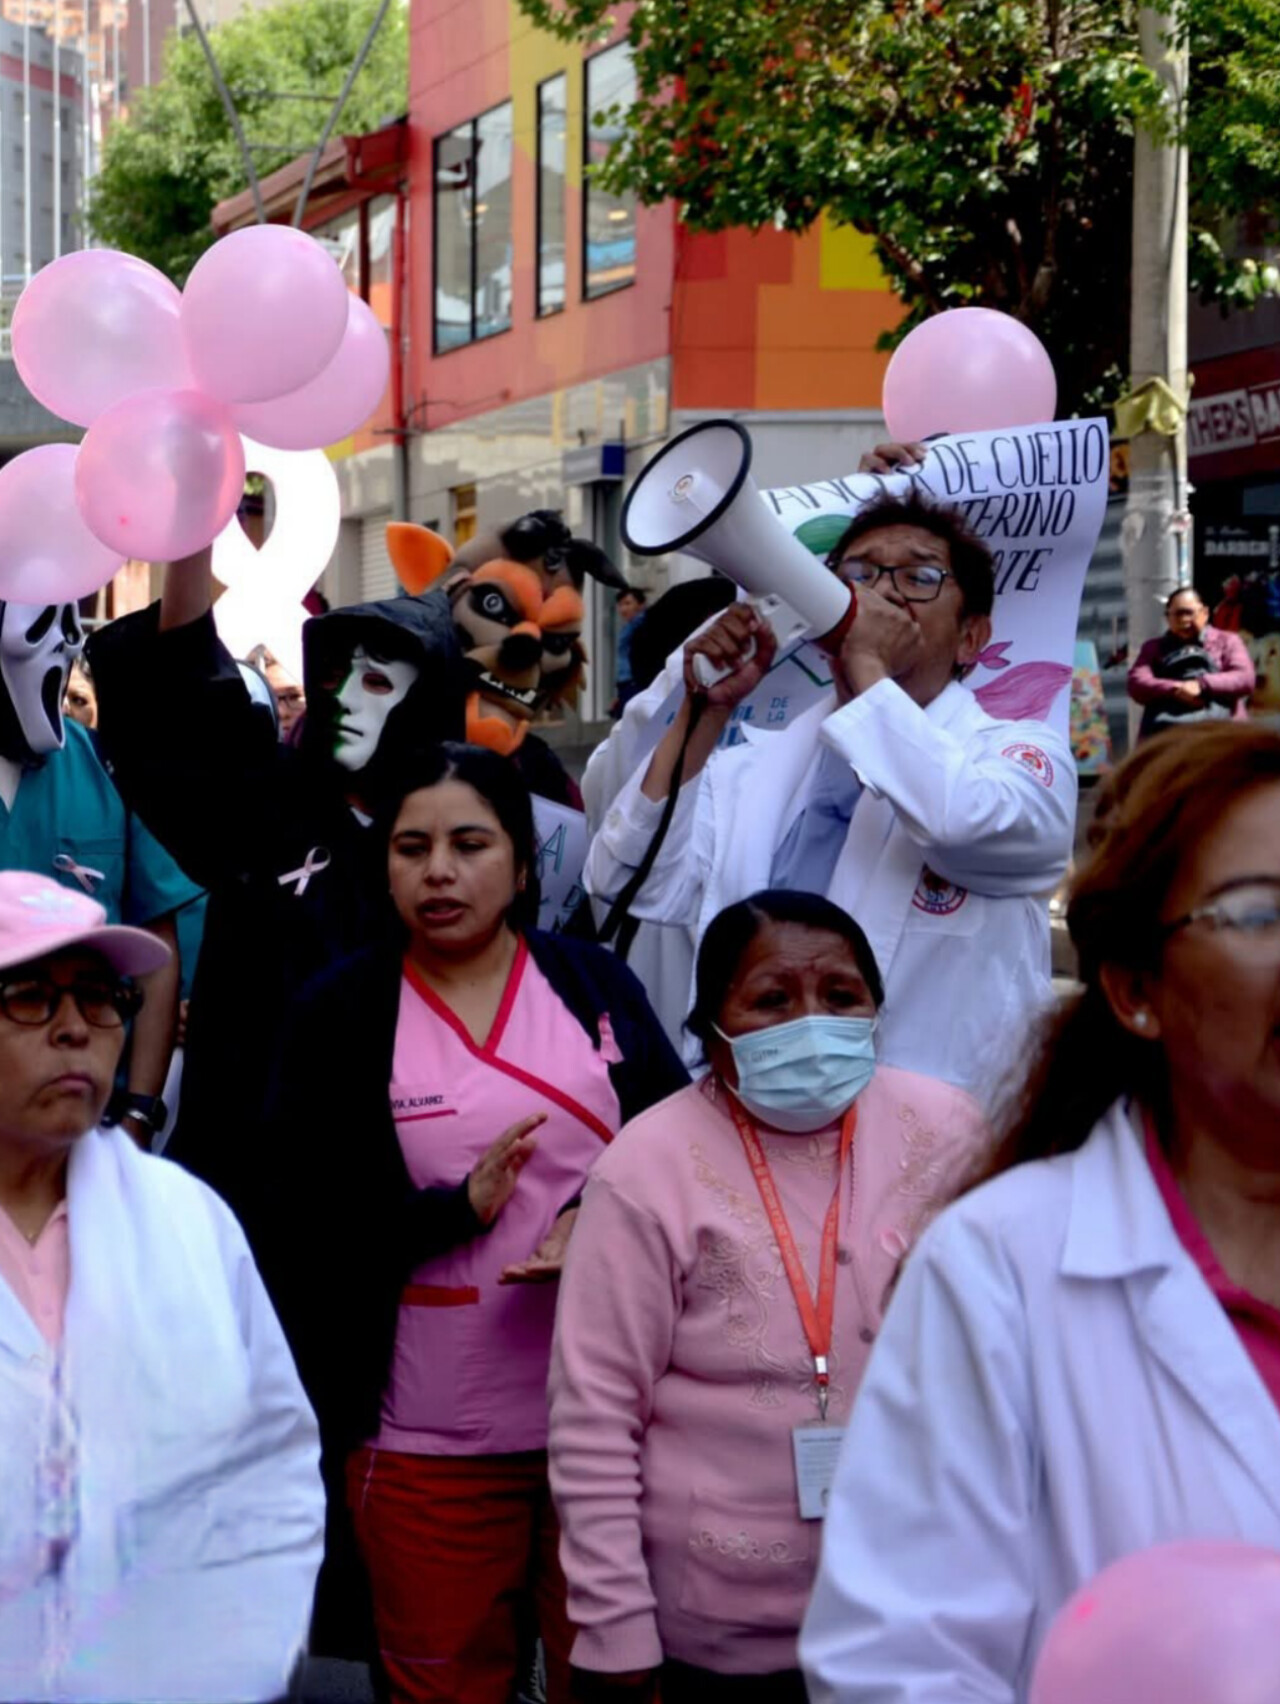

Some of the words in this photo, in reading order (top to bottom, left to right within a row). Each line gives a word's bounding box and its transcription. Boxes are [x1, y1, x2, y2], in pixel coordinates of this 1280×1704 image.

[1187, 399, 1250, 447] THERS
[930, 439, 989, 496] DE
[991, 423, 1106, 489] CUELLO
[932, 489, 1076, 539] TERINO
[770, 697, 789, 709] DE
